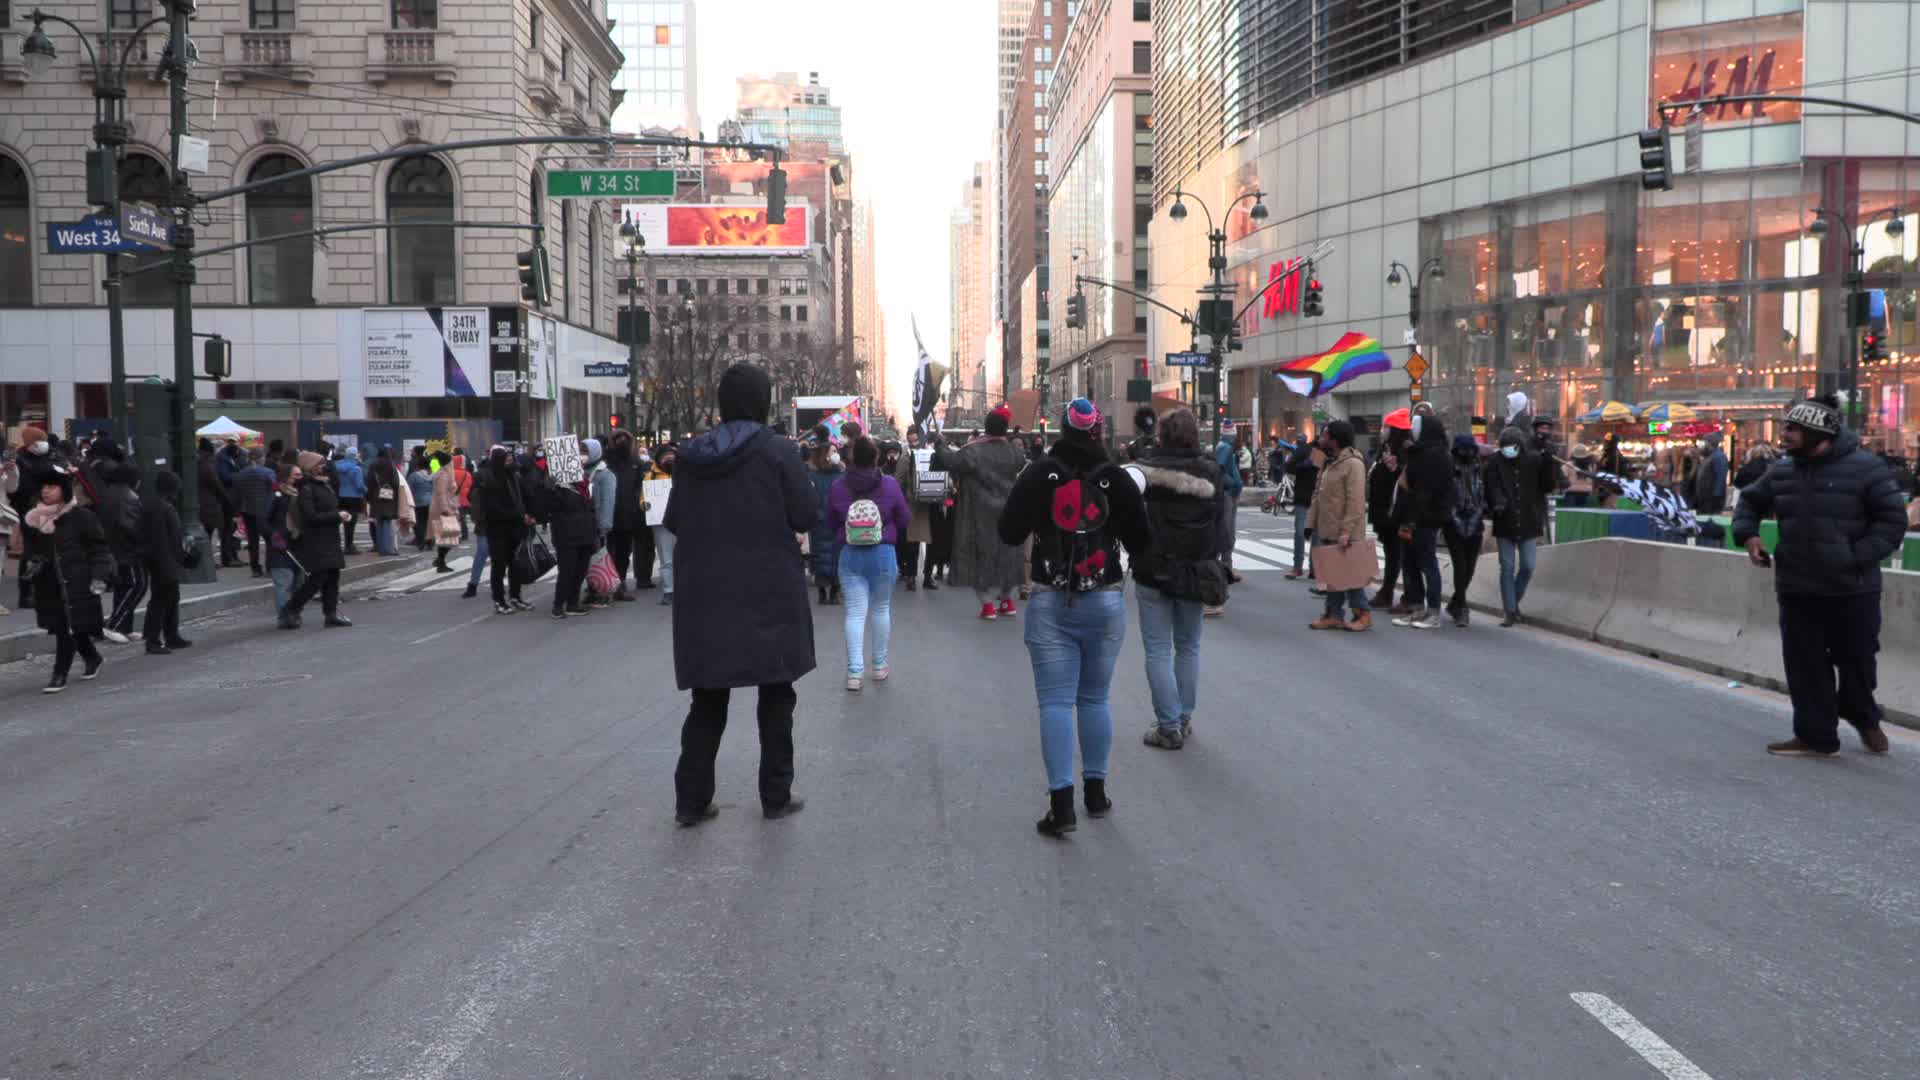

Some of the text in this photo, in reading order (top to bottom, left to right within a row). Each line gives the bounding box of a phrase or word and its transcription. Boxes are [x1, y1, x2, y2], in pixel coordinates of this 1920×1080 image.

[580, 175, 641, 193] W 34 St
[128, 214, 167, 241] Sixth Ave
[57, 229, 121, 246] West 34
[452, 315, 476, 328] 34TH
[452, 330, 480, 343] BWAY
[545, 436, 578, 457] BLACK
